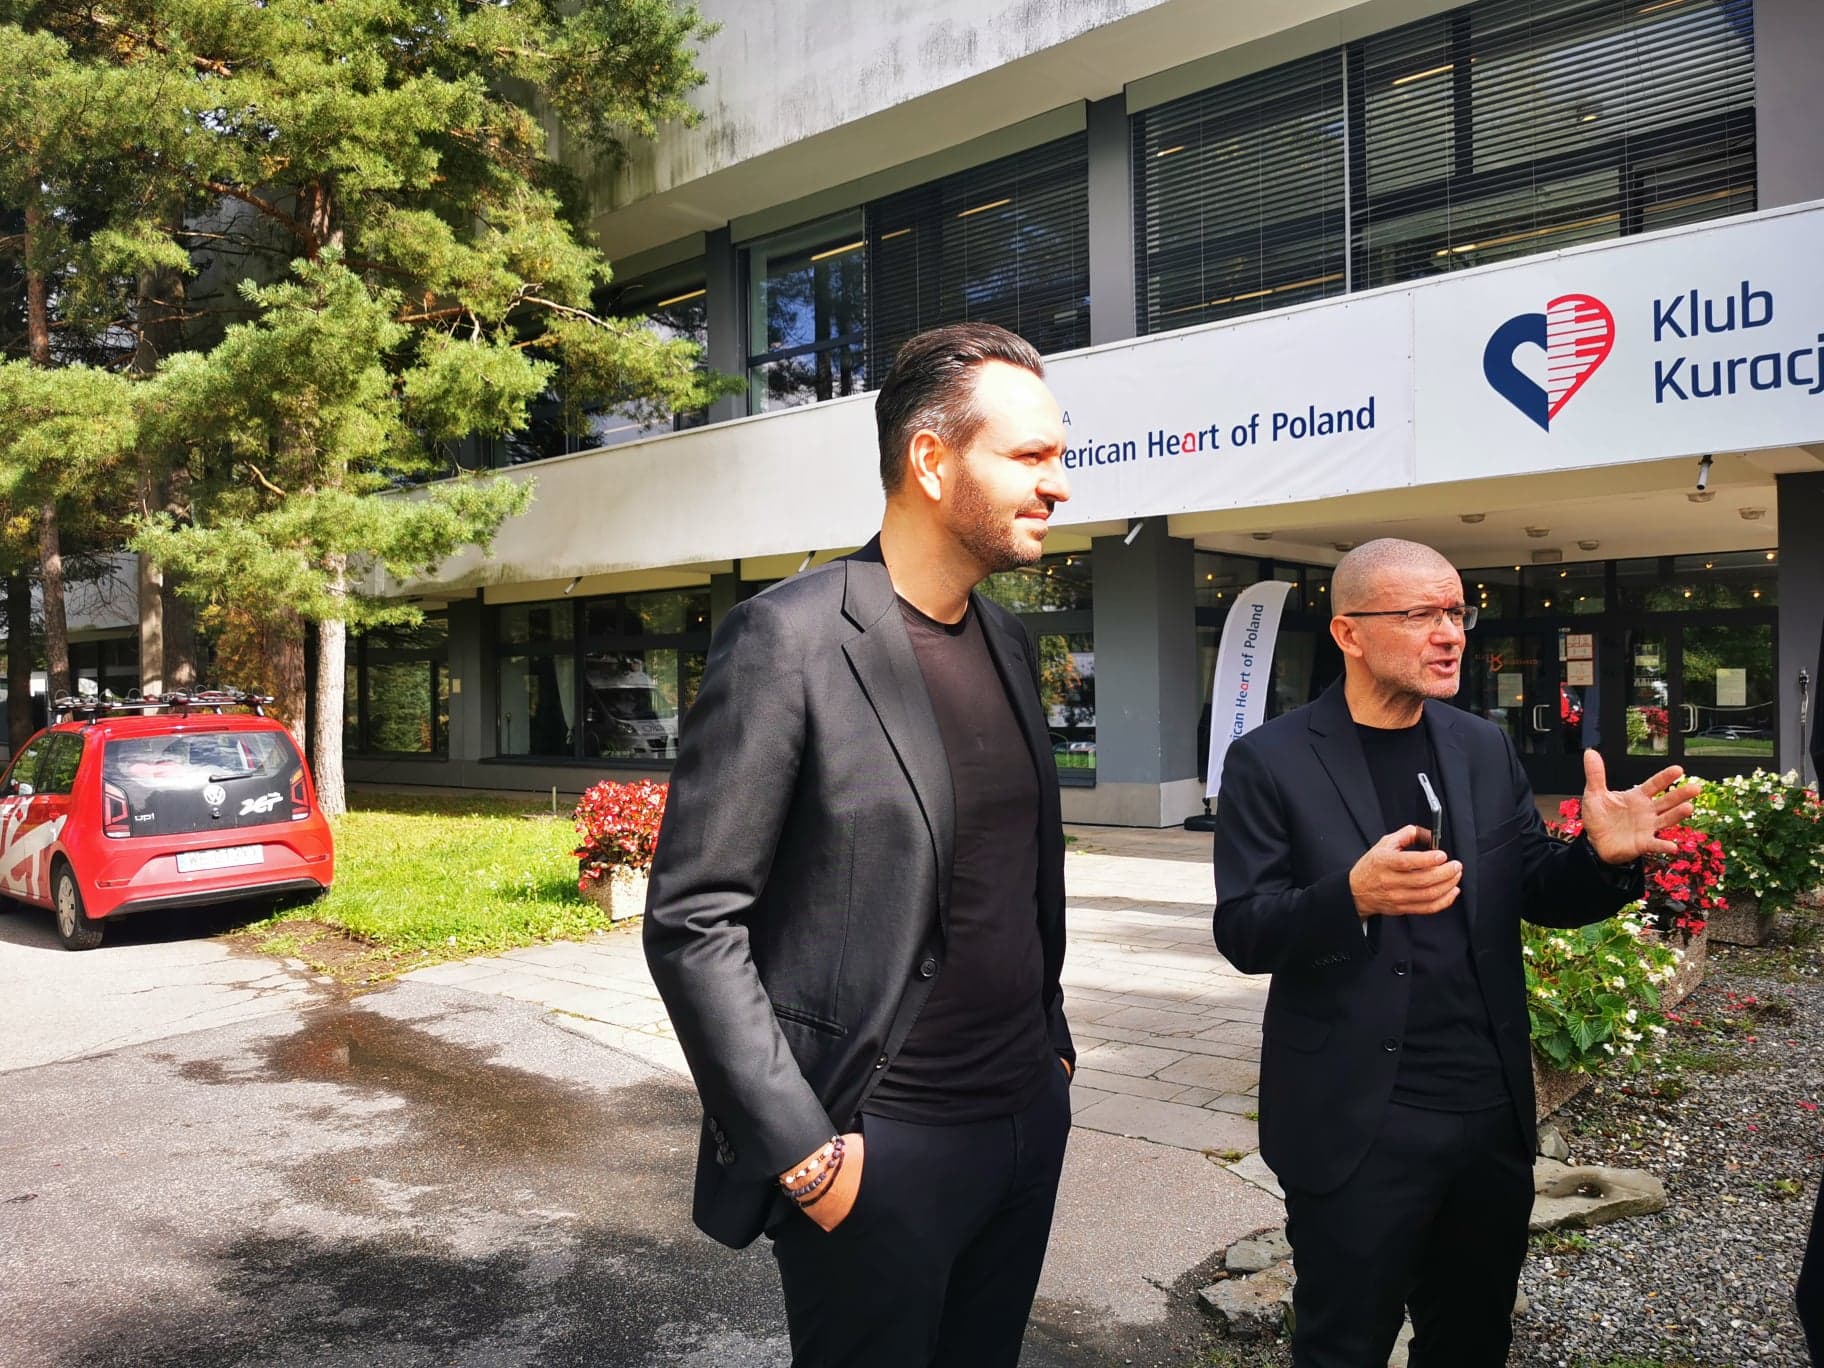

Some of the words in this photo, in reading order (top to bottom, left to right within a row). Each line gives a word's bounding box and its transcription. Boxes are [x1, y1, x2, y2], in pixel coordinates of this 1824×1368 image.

[1653, 280, 1774, 342] Klub
[1654, 333, 1824, 404] Kuracj
[1062, 439, 1136, 469] erican
[1148, 423, 1220, 459] Heart
[1231, 413, 1260, 447] of
[1272, 395, 1375, 442] Poland
[1243, 604, 1264, 649] Poland
[1241, 652, 1254, 667] of
[1235, 671, 1250, 708] Heart
